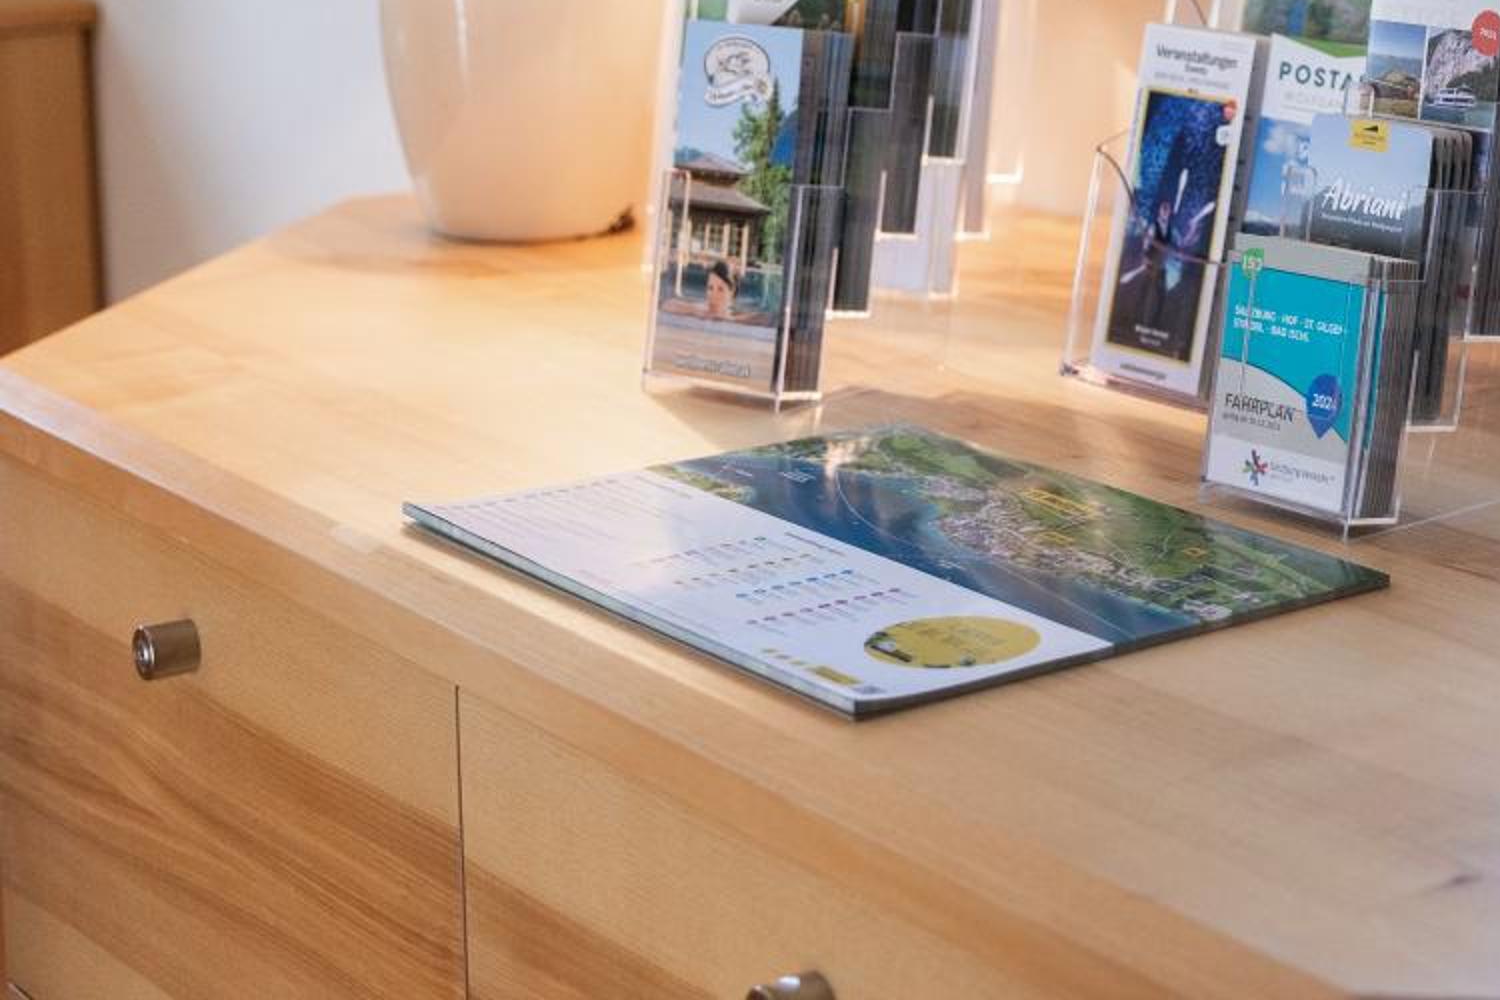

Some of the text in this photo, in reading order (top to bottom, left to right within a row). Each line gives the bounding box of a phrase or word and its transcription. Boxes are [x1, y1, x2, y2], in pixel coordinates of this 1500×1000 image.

[1156, 43, 1239, 71] Veranstaltungen
[1279, 60, 1364, 91] POSTA
[1224, 393, 1296, 423] FAHRPLAN
